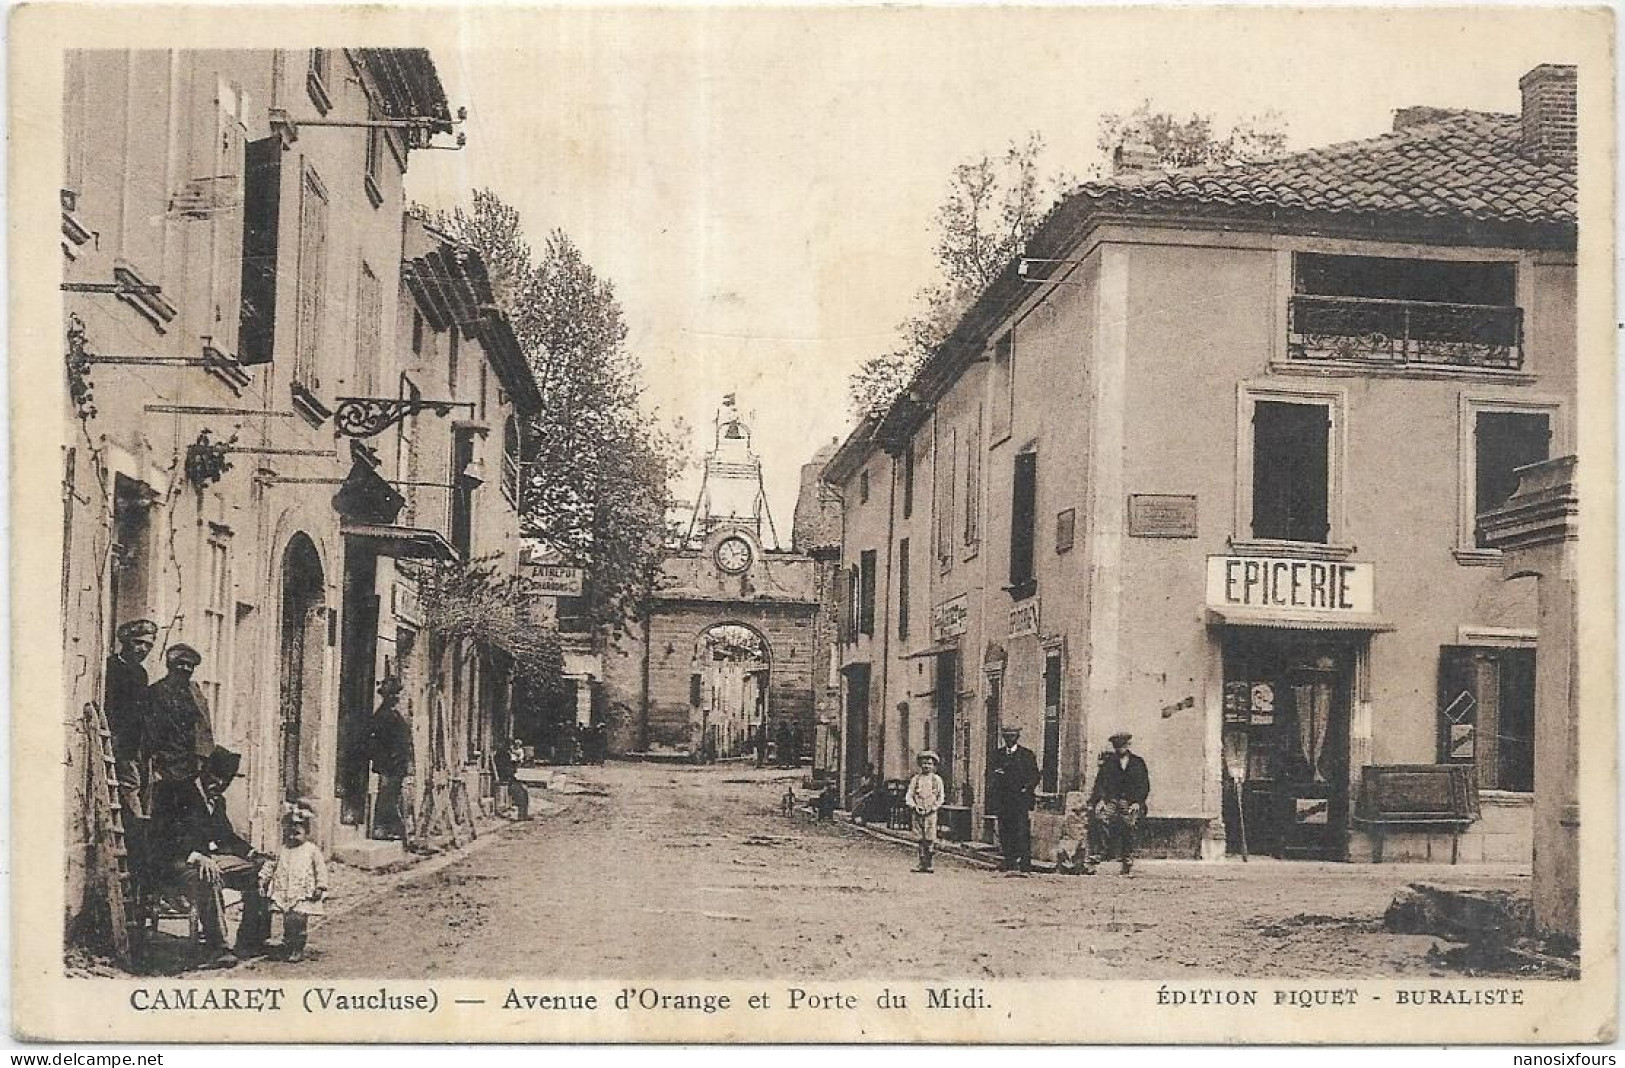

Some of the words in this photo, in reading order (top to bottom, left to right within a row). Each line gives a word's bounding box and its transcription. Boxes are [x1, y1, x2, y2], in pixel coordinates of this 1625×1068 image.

[1225, 559, 1356, 609] EPICERIE
[129, 988, 285, 1011] CAMARET
[303, 988, 439, 1013] (Vaucluse)
[502, 988, 597, 1010] Avenue
[615, 988, 731, 1014] d'Orange
[747, 992, 768, 1009] et
[788, 988, 857, 1010] Porte
[876, 988, 907, 1010] du
[925, 988, 992, 1010] Midi.
[1156, 985, 1258, 1006] ÉDITION
[1395, 989, 1524, 1006] BURALISTE
